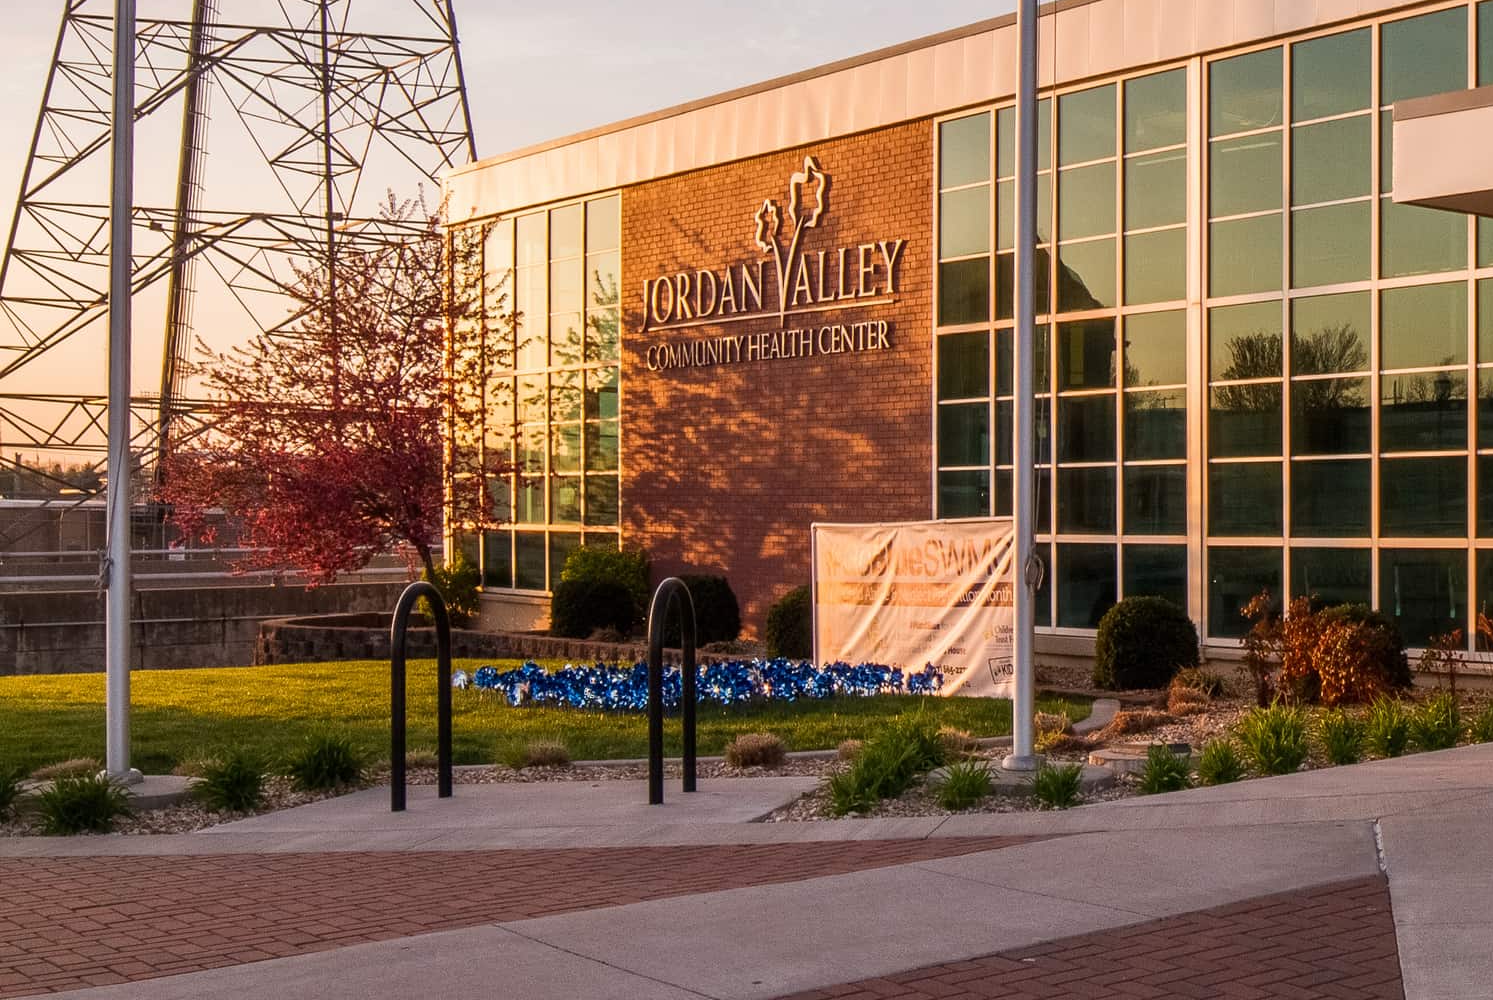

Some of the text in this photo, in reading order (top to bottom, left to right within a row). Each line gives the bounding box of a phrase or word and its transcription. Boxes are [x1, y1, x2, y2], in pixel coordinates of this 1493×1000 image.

[639, 216, 904, 334] JORDAN VALLEY
[646, 319, 891, 372] COMMUNITY HEALTH CENTER
